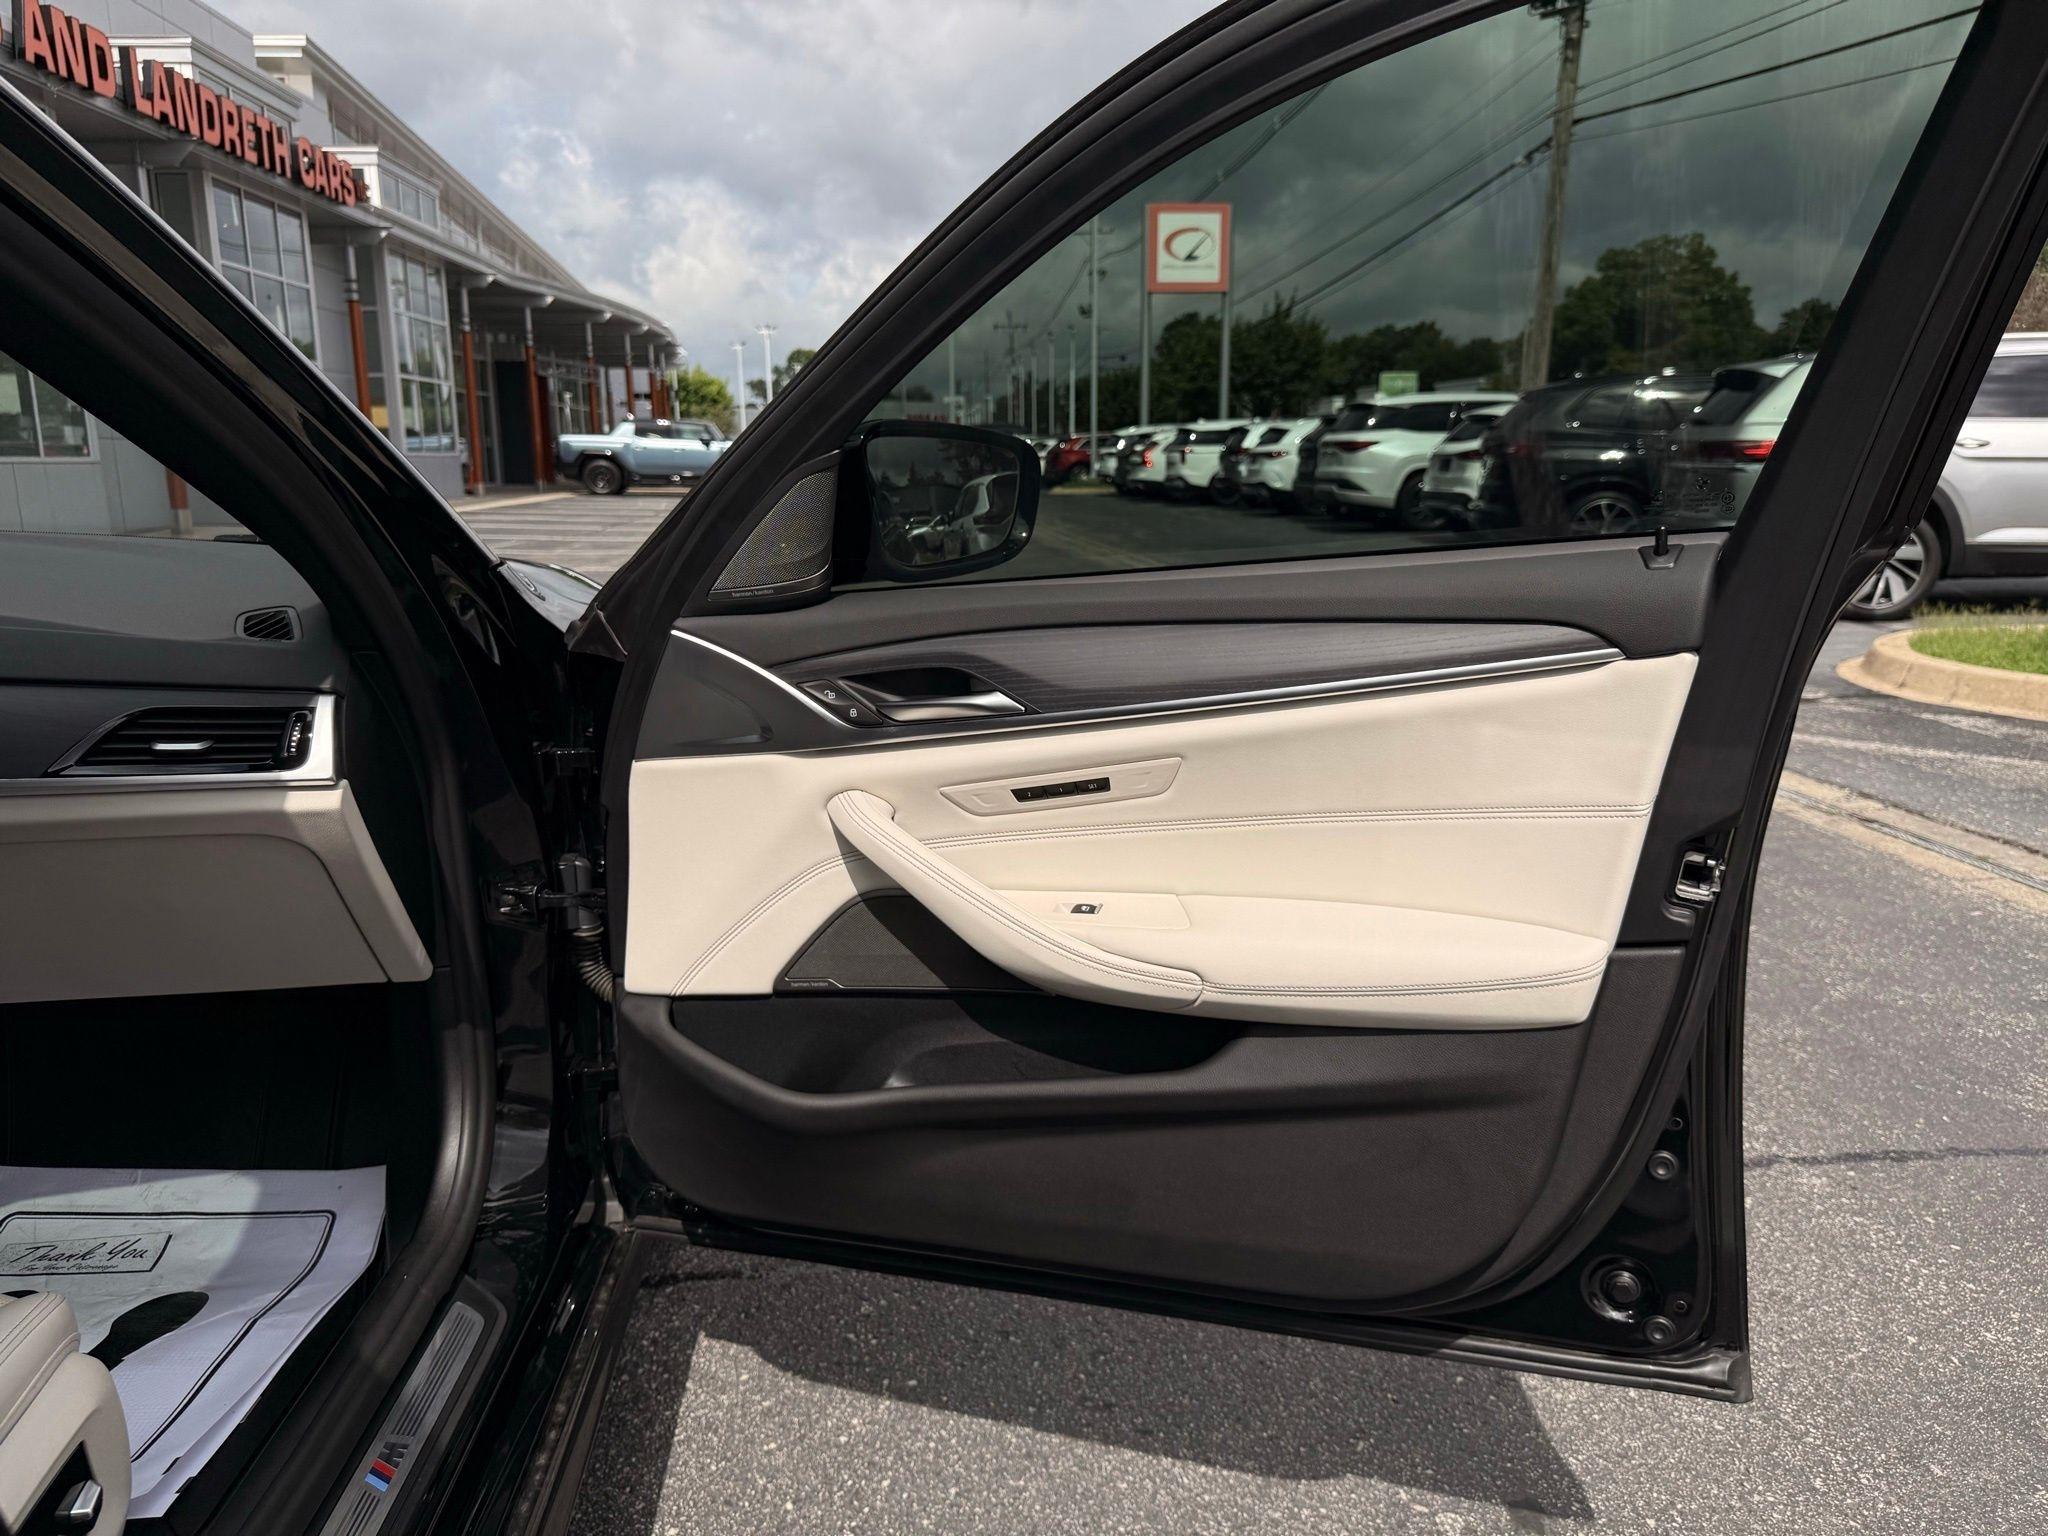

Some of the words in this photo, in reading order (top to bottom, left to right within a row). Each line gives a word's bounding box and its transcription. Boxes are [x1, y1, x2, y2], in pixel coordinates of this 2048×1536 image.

[23, 0, 117, 98] AND
[129, 46, 292, 180] LANDRETH
[297, 136, 357, 208] CARS
[9, 1241, 107, 1264] Thank
[107, 1237, 149, 1262] You
